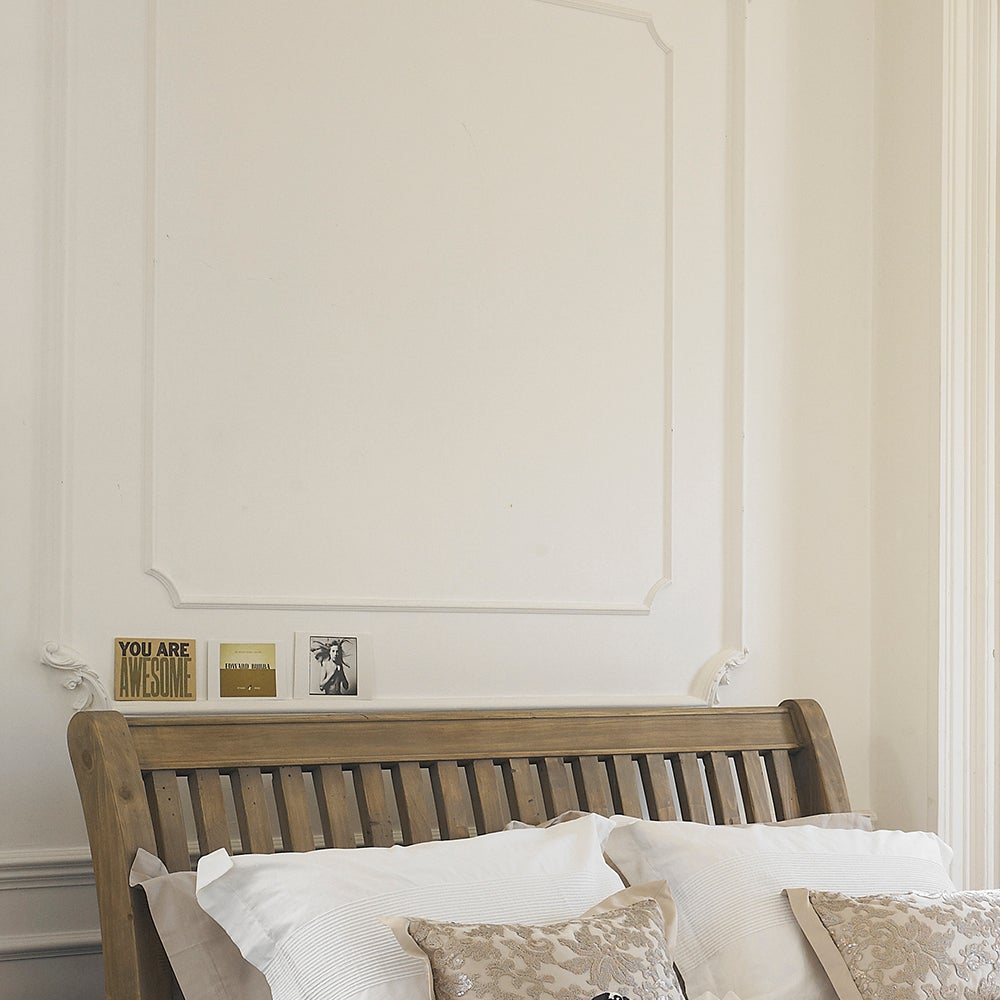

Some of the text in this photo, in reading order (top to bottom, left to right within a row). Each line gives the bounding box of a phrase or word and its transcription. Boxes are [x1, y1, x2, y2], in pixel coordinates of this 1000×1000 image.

[119, 641, 190, 657] YOU ARE
[119, 657, 193, 698] AWESOME
